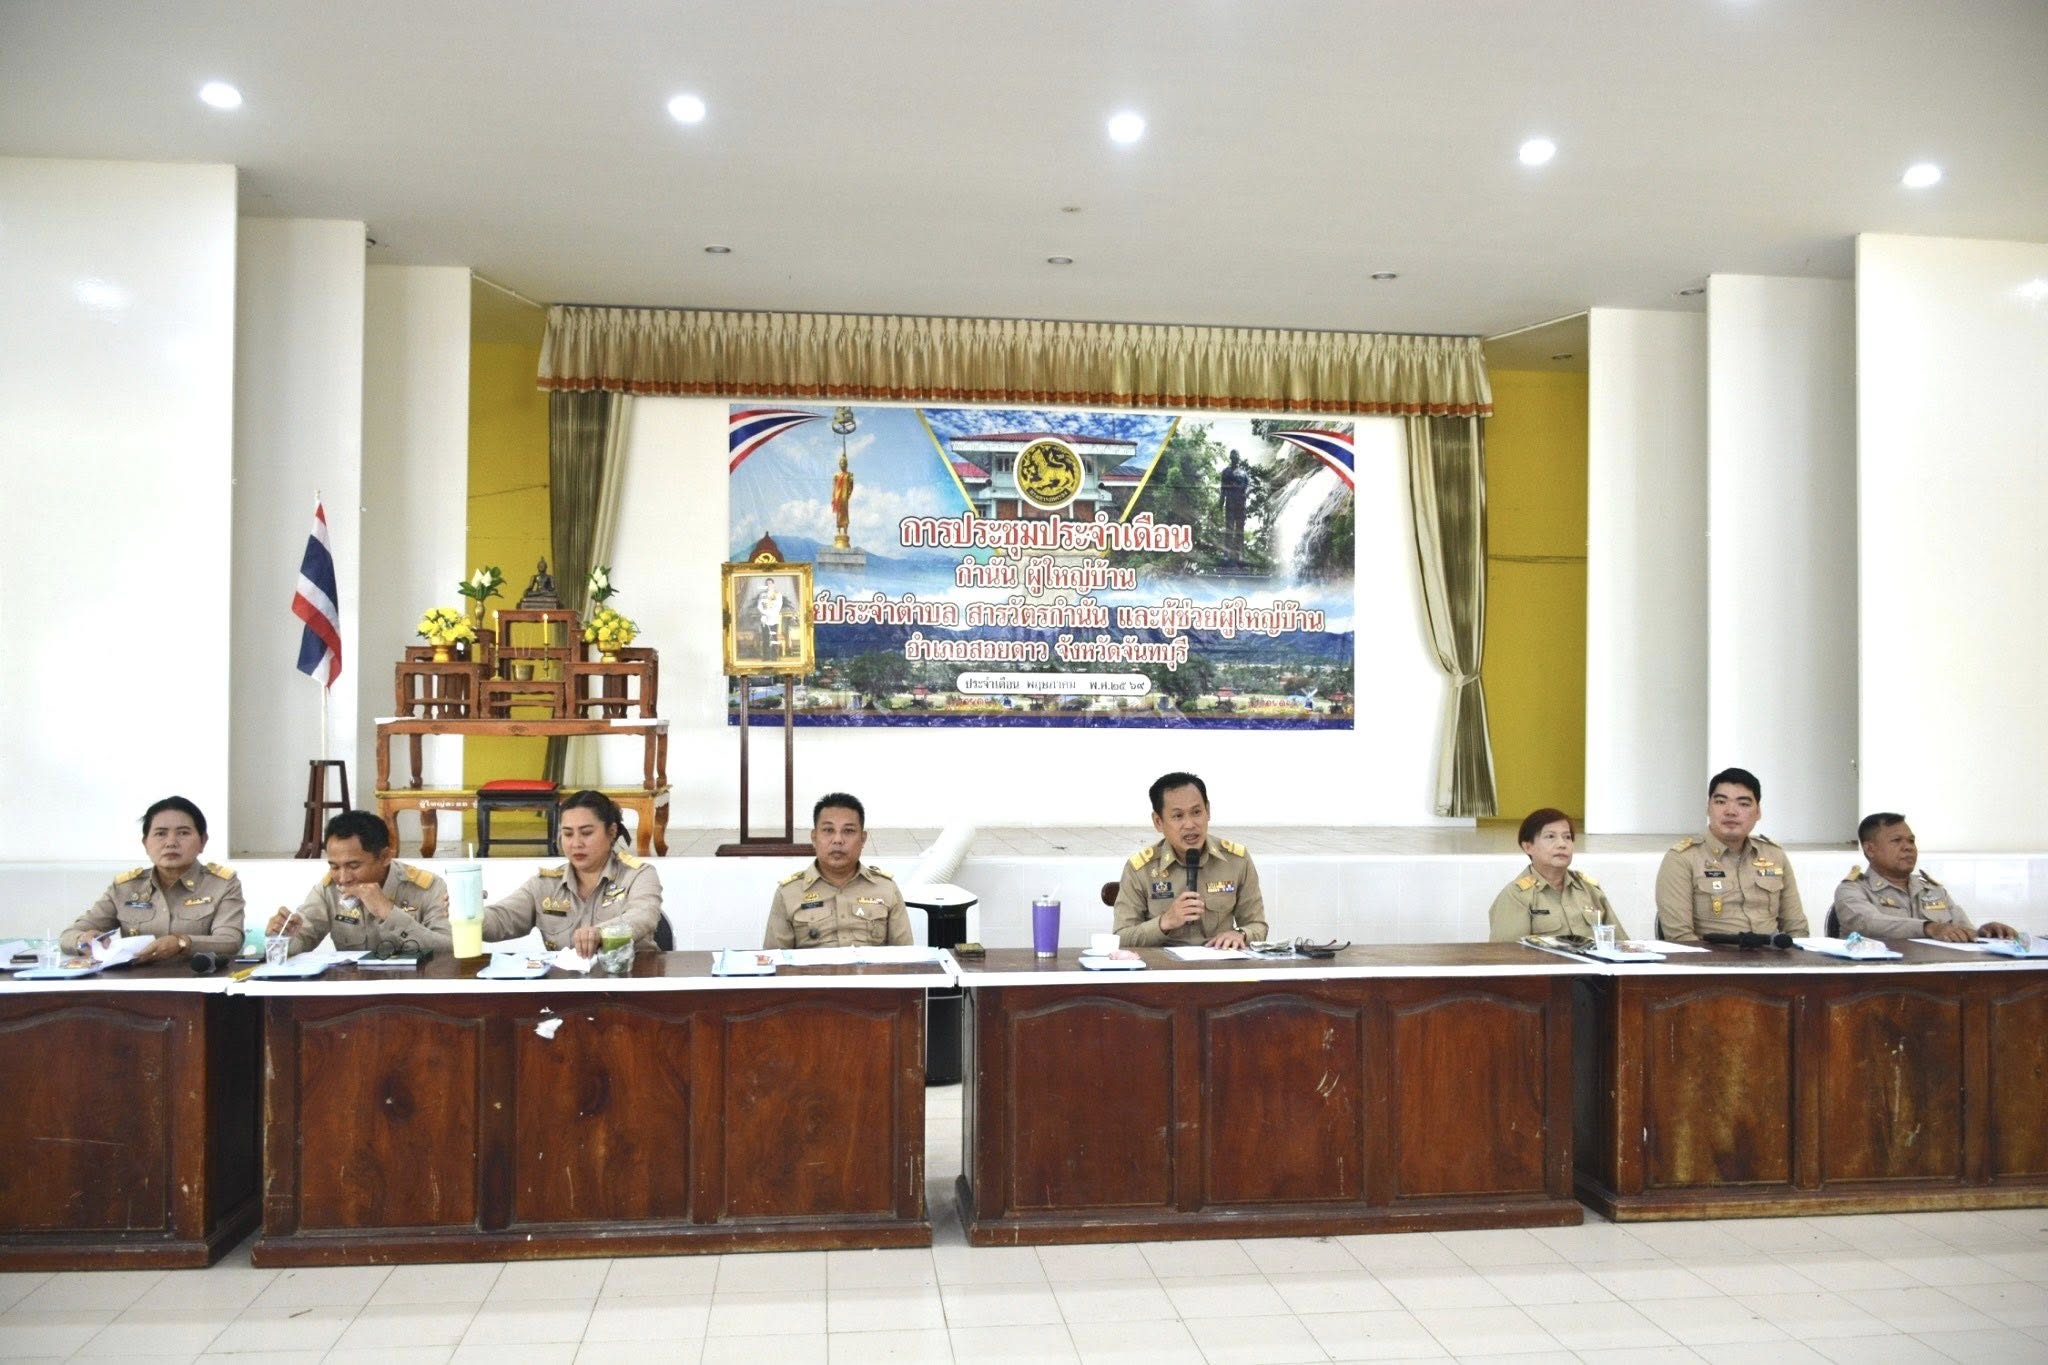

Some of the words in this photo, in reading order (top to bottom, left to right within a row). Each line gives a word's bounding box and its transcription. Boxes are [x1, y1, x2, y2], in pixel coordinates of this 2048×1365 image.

[901, 512, 1191, 557] การประชุมประจำเดือน
[957, 556, 1017, 588] กำนัน
[1026, 557, 1136, 595] ผู้ใหญ่บ้าน
[813, 590, 958, 625] ย์ประจำตำบล
[966, 596, 1109, 628] สารวัตรกำนัน
[1116, 597, 1325, 638] และผู้ช่วยผู้ใหญ่บ้าน
[906, 633, 1049, 660] อำเภอสอยดาว
[1055, 635, 1188, 670] จังหวัดจันทบุรี
[965, 676, 1020, 689] ประจำเดือน
